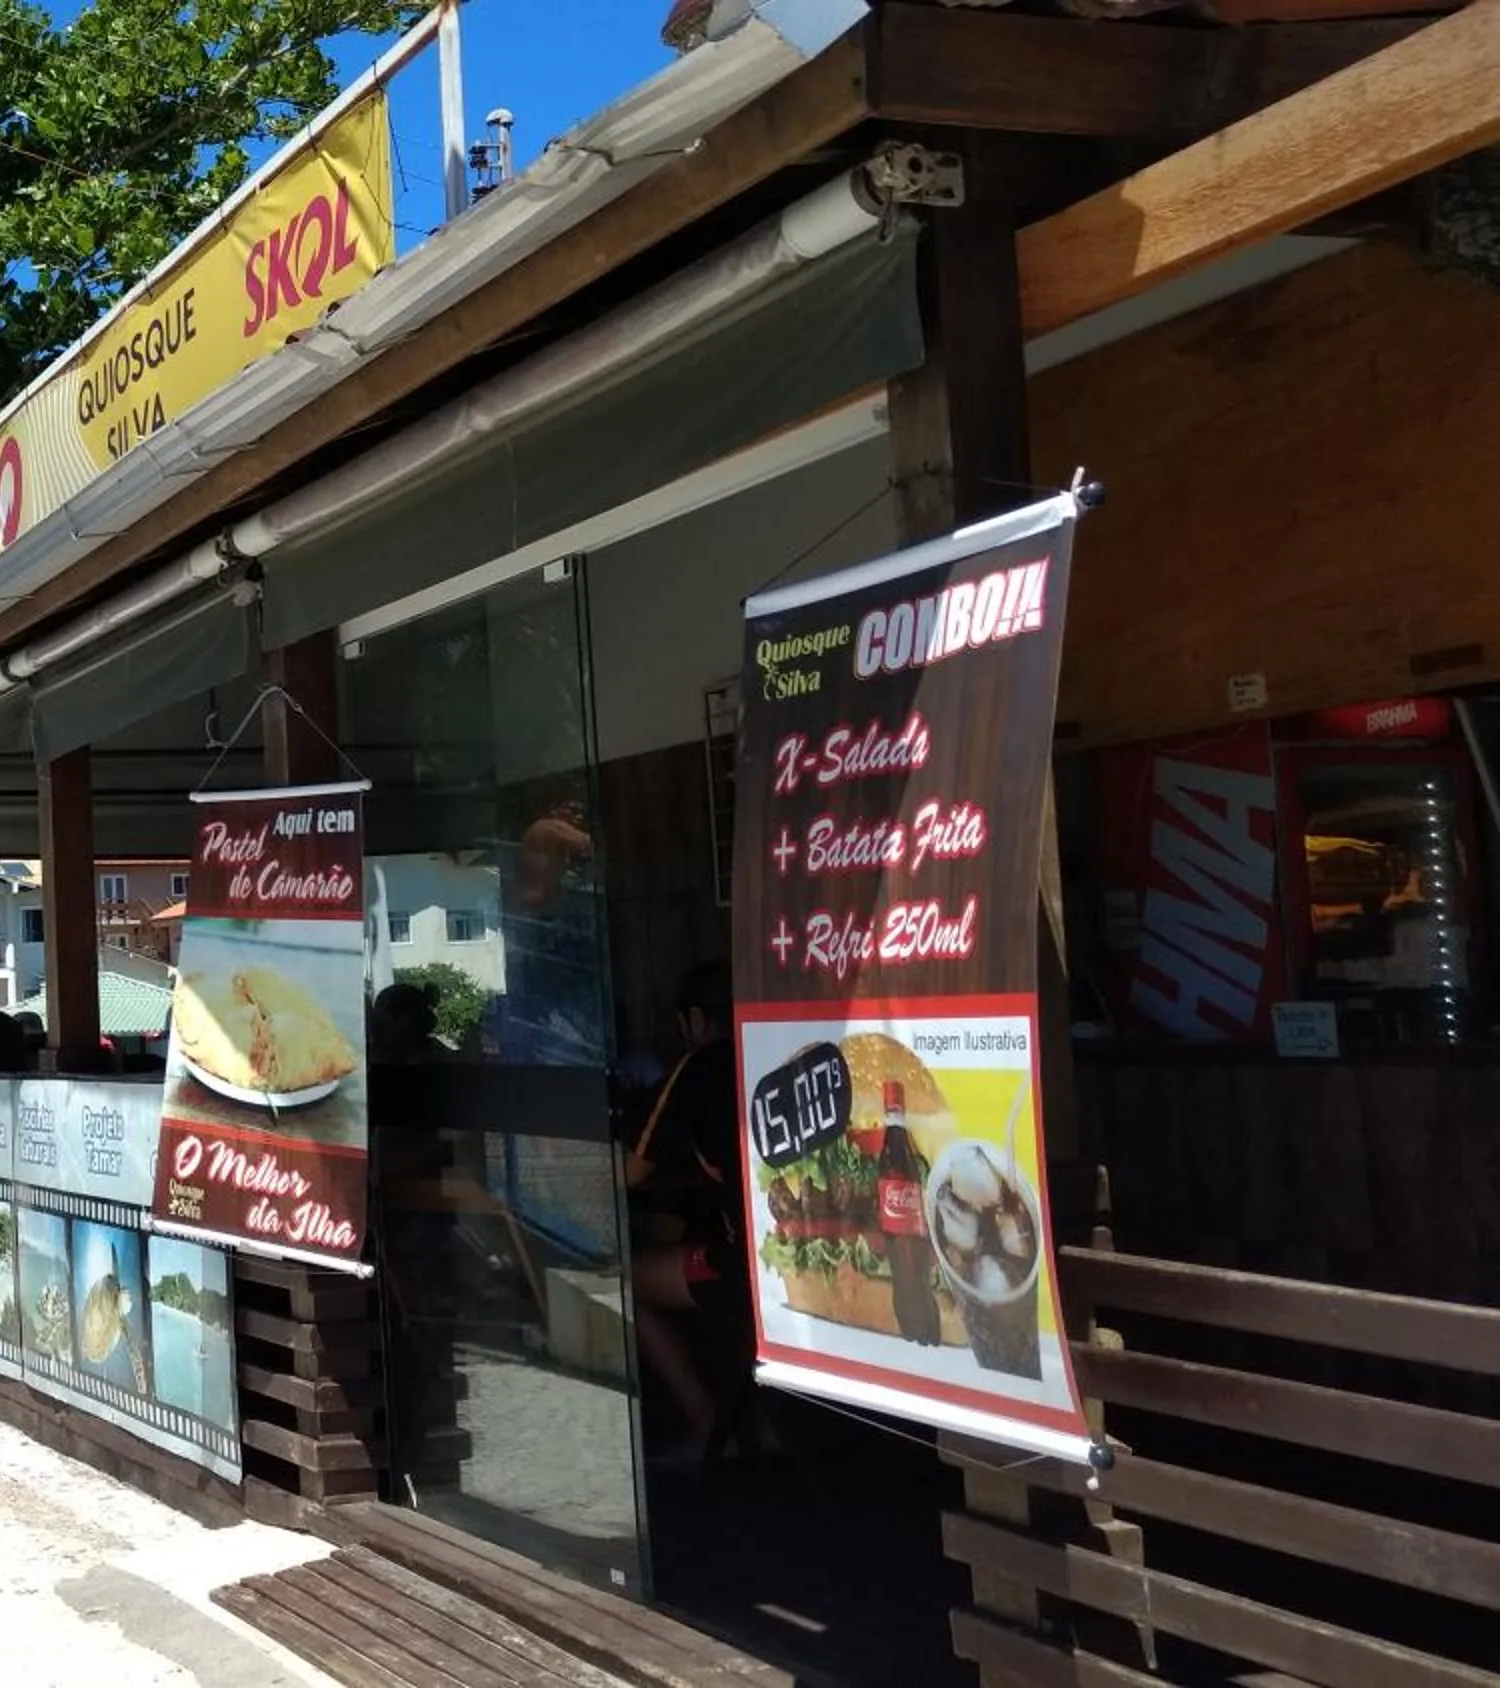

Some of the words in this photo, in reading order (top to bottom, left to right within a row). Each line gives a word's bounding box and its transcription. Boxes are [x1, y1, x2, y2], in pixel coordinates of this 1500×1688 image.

[243, 177, 359, 338] SKOL
[78, 288, 197, 426] QUIOSQUE
[756, 623, 851, 670] Quiosque
[854, 557, 1049, 682] COMBO!!!
[774, 667, 821, 699] Silva
[774, 714, 930, 793] X-Salada
[202, 821, 268, 863] Pastel
[272, 808, 314, 839] Aqui
[317, 809, 355, 833] tem
[807, 817, 905, 873] Batata
[912, 803, 984, 875] Frita
[229, 865, 253, 899] de
[257, 861, 354, 901] Camarão
[804, 911, 875, 979] Refri
[879, 900, 977, 960] 250ml
[913, 1033, 961, 1056] Imagem
[174, 1135, 202, 1179] O
[208, 1139, 312, 1200] Melhor
[246, 1197, 283, 1234] da
[283, 1199, 356, 1248] Ilha
